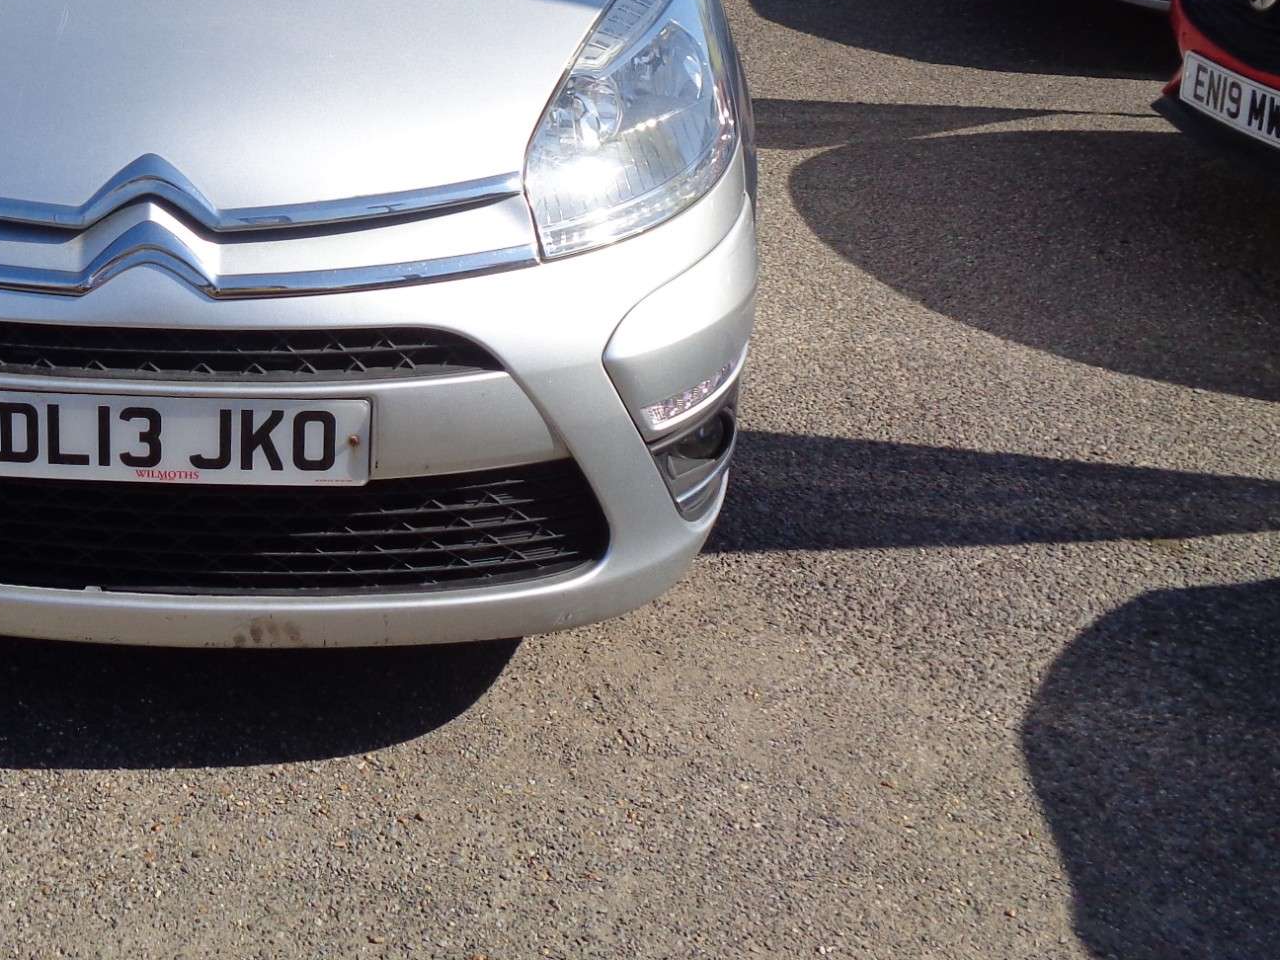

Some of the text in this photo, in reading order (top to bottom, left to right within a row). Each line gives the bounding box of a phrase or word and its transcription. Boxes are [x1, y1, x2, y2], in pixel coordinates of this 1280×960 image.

[1193, 64, 1242, 119] EN19
[189, 408, 337, 472] JKO
[135, 469, 200, 480] WILMOTHS
